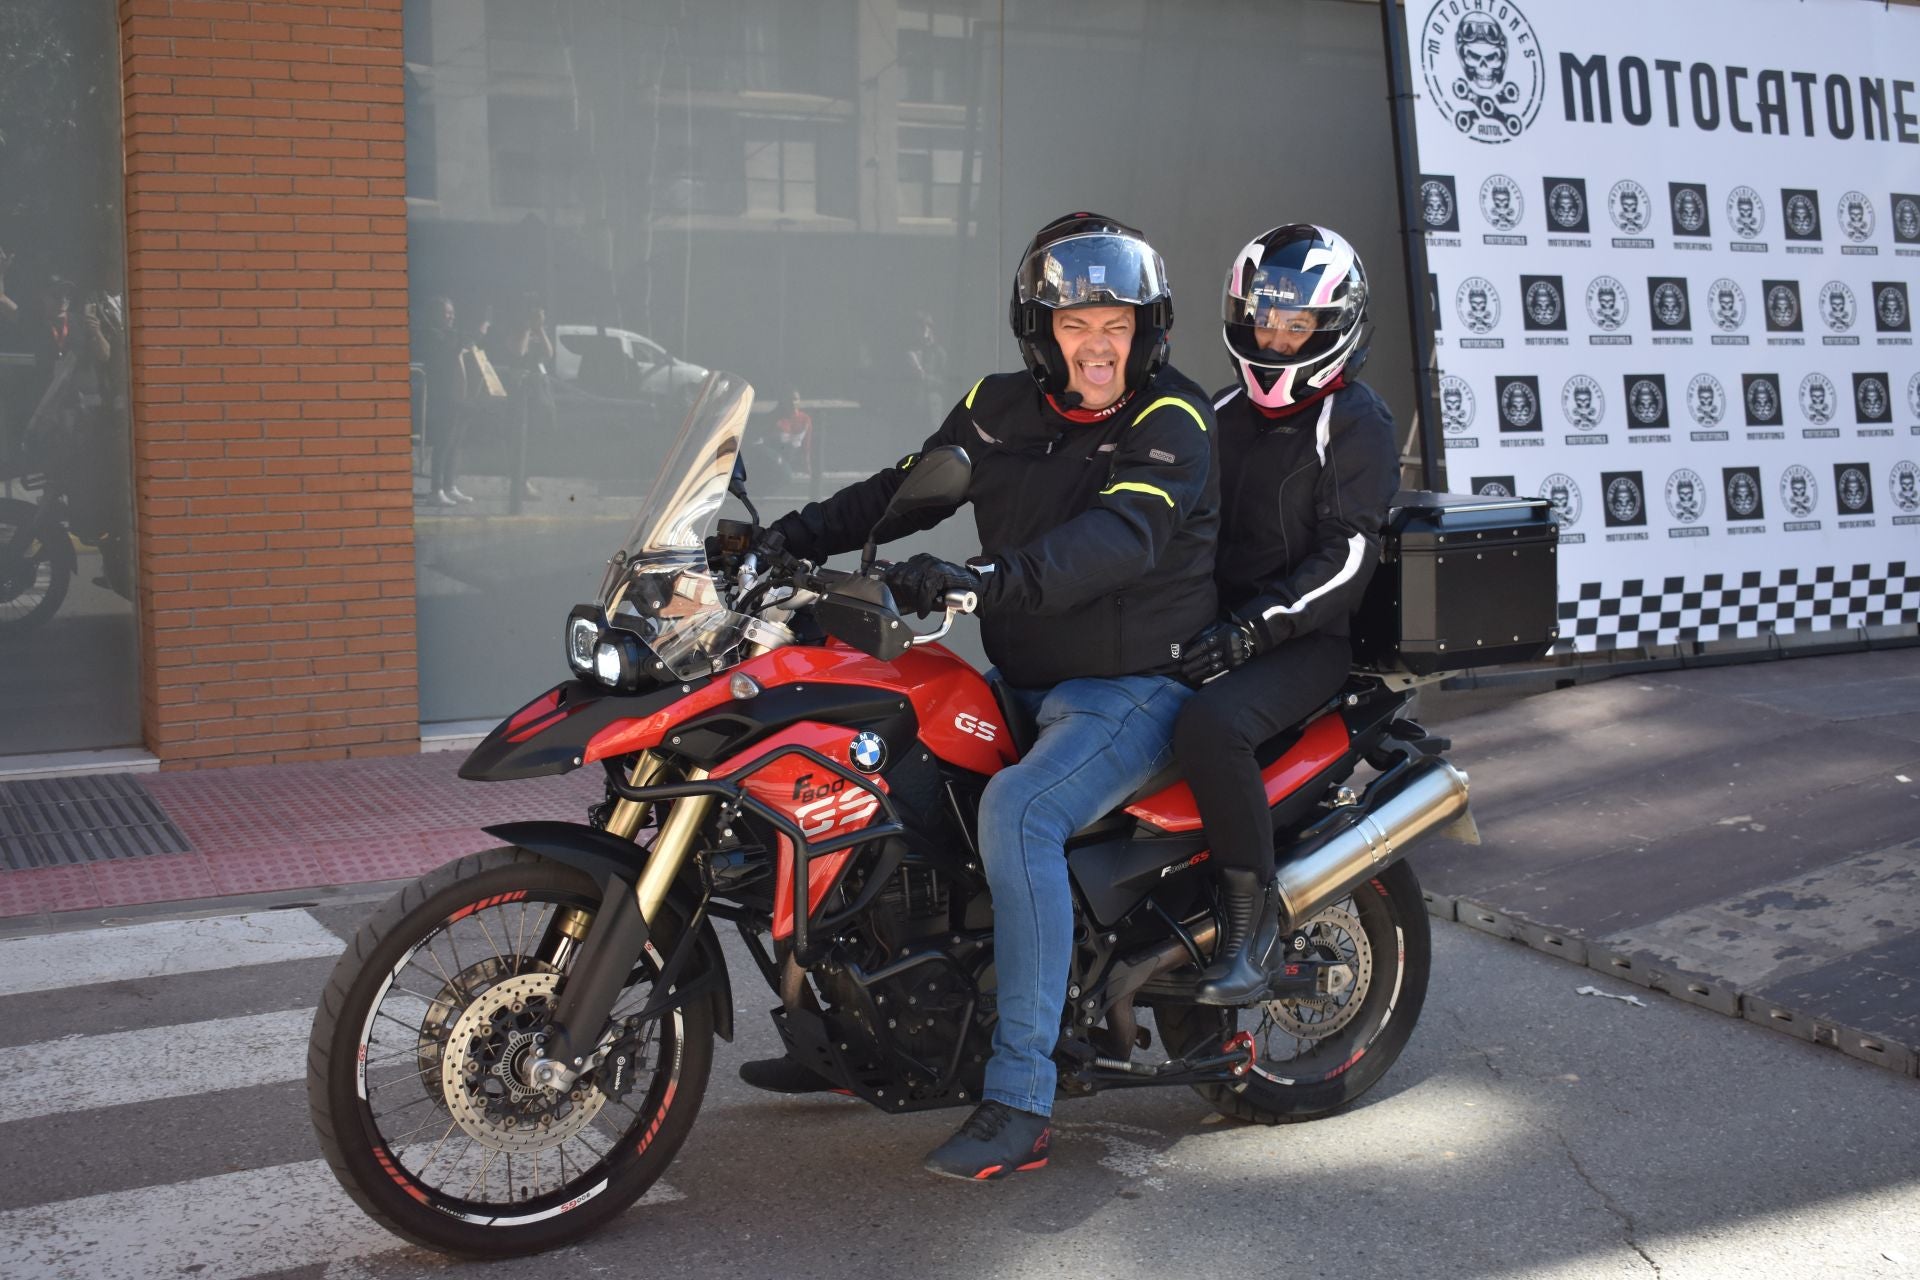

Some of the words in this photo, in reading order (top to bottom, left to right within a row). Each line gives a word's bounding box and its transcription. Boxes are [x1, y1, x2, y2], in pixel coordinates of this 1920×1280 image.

[1559, 52, 1920, 144] MOTOCATONE
[850, 733, 881, 750] BMW
[955, 712, 998, 742] GS
[794, 778, 880, 838] GS
